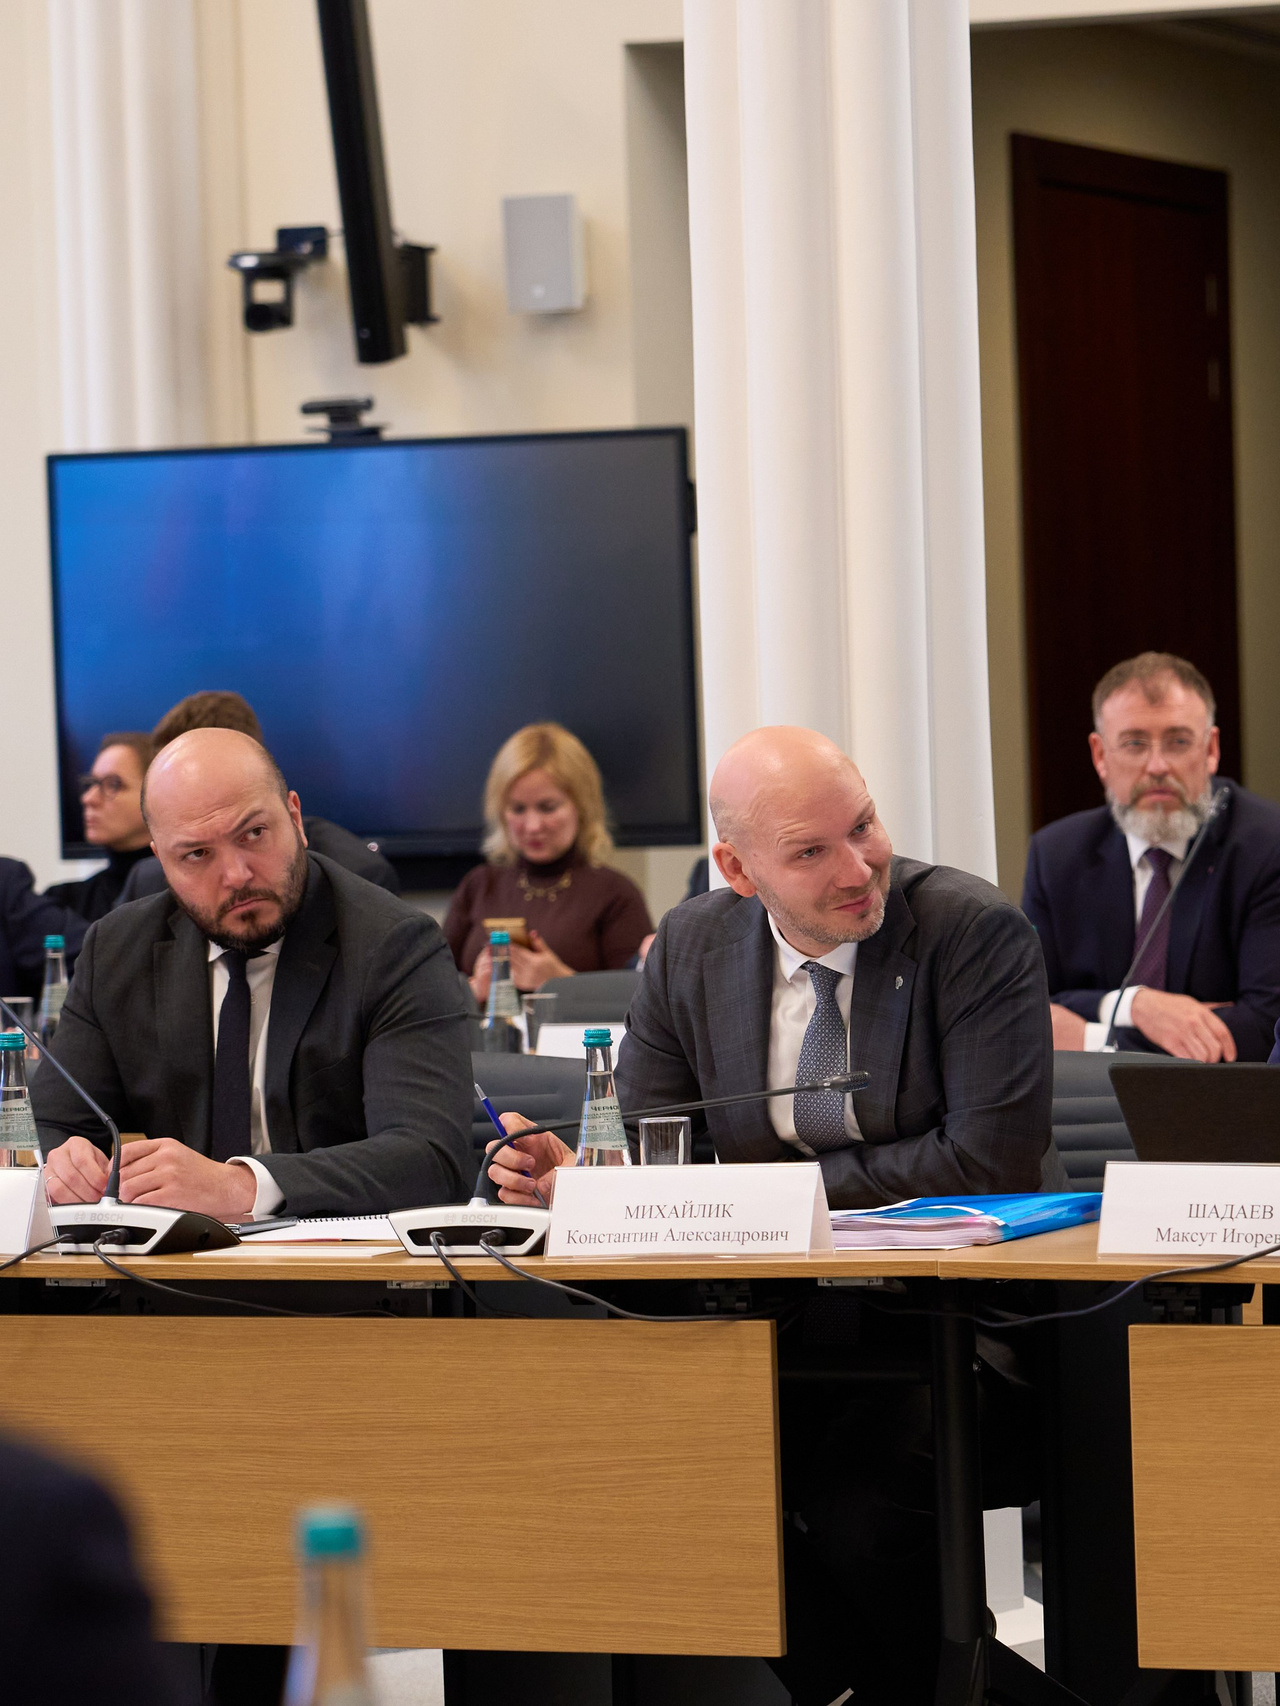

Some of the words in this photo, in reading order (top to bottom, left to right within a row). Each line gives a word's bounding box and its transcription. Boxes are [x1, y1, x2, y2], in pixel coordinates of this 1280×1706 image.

[89, 1212, 124, 1222] BOSCH
[461, 1213, 498, 1223] BOSCH
[624, 1200, 734, 1220] МИХАЙЛИК
[1187, 1203, 1275, 1221] ШАДАЕВ
[566, 1229, 659, 1245] Константин
[663, 1227, 790, 1246] Александрович
[1155, 1227, 1218, 1247] Максут
